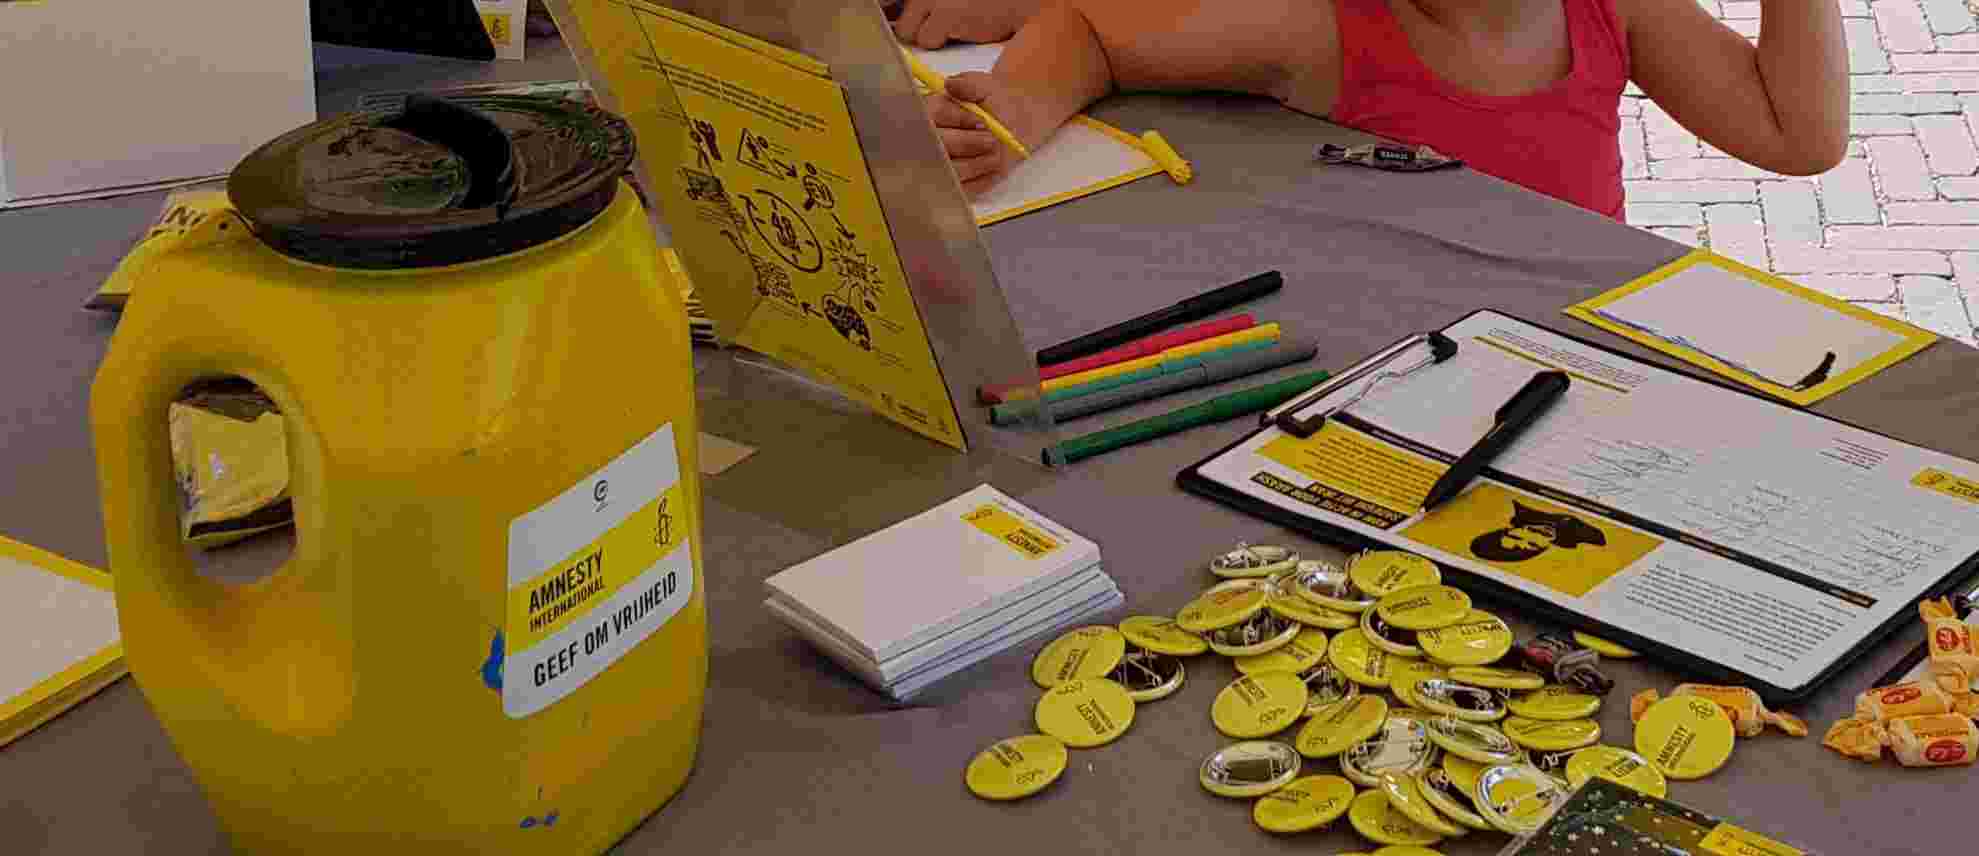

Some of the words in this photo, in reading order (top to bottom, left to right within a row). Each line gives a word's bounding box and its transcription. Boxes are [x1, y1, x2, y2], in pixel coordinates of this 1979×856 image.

[528, 548, 603, 614] AMNESTY
[529, 575, 604, 632] INTERNATIONAL
[533, 640, 578, 688] GEEF
[584, 620, 608, 656] OM
[612, 571, 677, 636] VRIJHEID
[1655, 723, 1688, 767] AMNESTY
